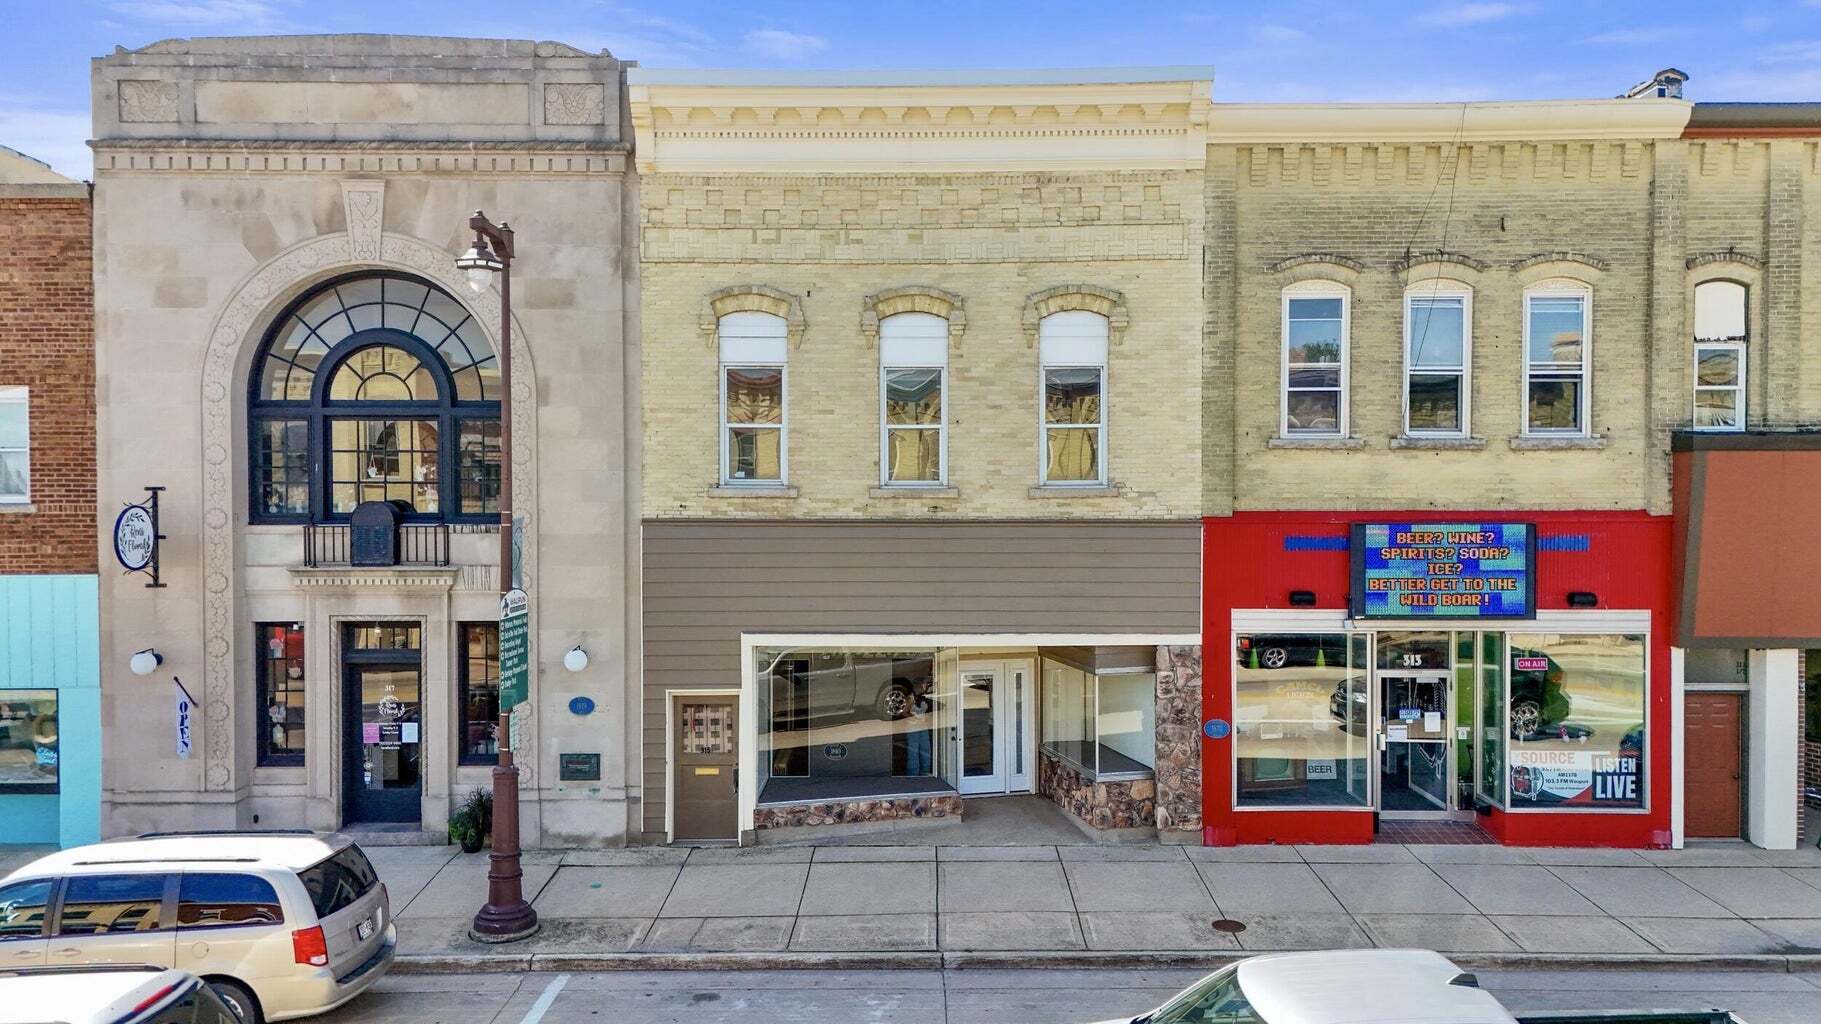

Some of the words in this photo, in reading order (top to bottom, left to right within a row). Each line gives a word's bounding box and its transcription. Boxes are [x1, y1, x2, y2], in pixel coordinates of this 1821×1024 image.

[1396, 532, 1444, 545] BEER?
[1448, 532, 1495, 545] WINE?
[1381, 548, 1454, 560] SPIRITS?
[1459, 548, 1510, 560] SODA?
[1427, 563, 1464, 575] ICE?
[1368, 578, 1427, 591] BETTER
[1430, 578, 1459, 591] GET
[1464, 578, 1483, 591] TO
[1488, 578, 1517, 591] THE
[1400, 593, 1437, 606] WILD
[1441, 593, 1489, 606] BOAR!
[1403, 654, 1422, 666] 313
[1518, 660, 1531, 668] ON
[1532, 660, 1546, 668] AIR
[179, 701, 189, 753] OPEN
[1520, 751, 1576, 765] SOURCE
[1308, 765, 1333, 774] BEER
[1595, 757, 1637, 773] LISTEN
[1595, 775, 1637, 799] LIVE
